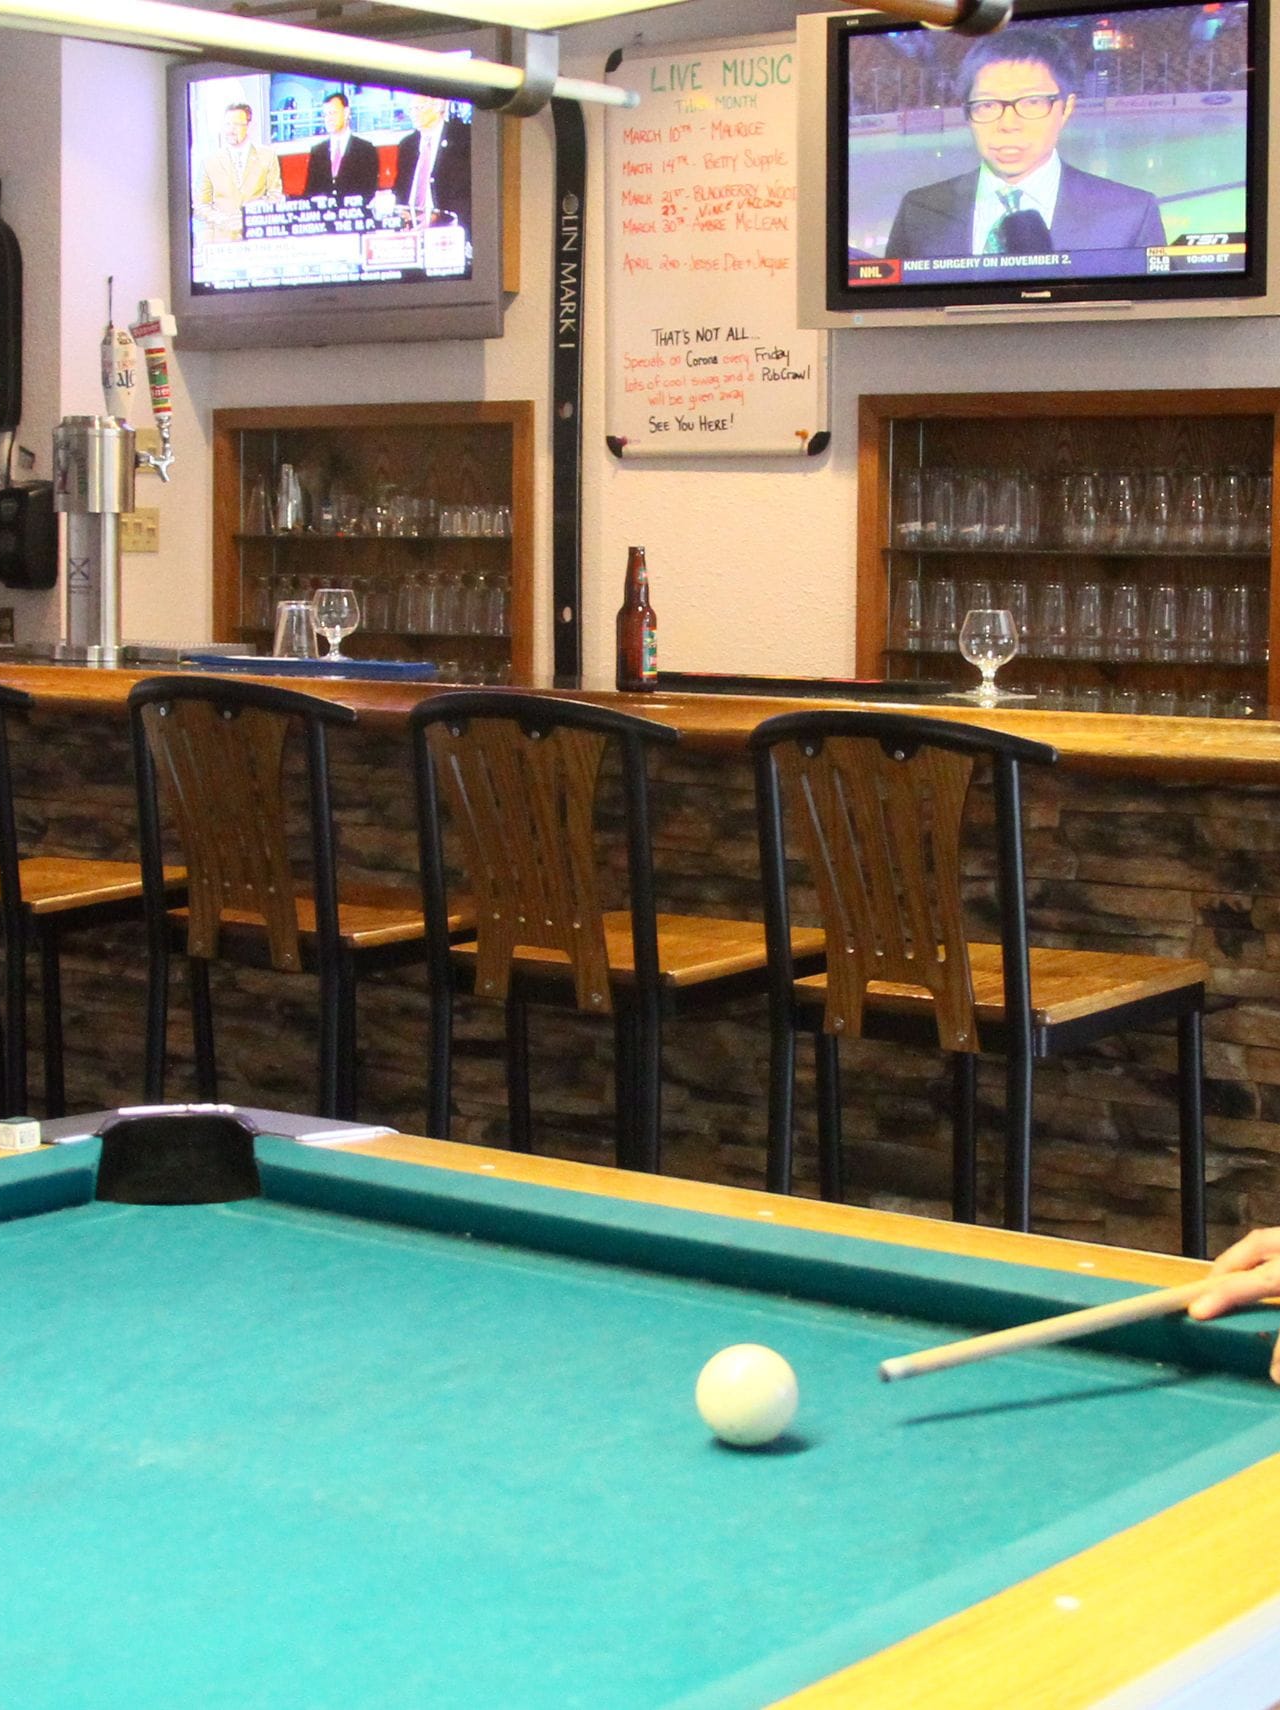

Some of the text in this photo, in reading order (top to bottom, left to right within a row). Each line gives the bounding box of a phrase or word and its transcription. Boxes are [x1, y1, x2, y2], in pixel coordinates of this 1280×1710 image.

[650, 54, 793, 91] LIVE MUSIC
[715, 94, 758, 110] MONTH
[623, 127, 662, 144] MARCH
[711, 120, 766, 140] MAURICE
[703, 152, 738, 173] BETTY
[621, 189, 653, 206] MARCH
[661, 204, 677, 216] 23
[622, 218, 657, 234] MARCH
[859, 254, 1072, 279] NHL KNEE SURGERY ON NOVEMBER 2.
[1186, 255, 1215, 264] 10:00
[1216, 254, 1230, 262] ET
[559, 262, 578, 334] MARK
[651, 328, 691, 346] THAT'S
[696, 327, 721, 341] NOT
[623, 352, 665, 370] Specials
[685, 350, 719, 367] Corona
[754, 346, 790, 366] Friday
[663, 376, 686, 388] cool
[648, 392, 665, 406] will
[669, 392, 684, 406] be
[719, 389, 745, 405] away
[648, 412, 734, 433] SEE YOU HERE!
